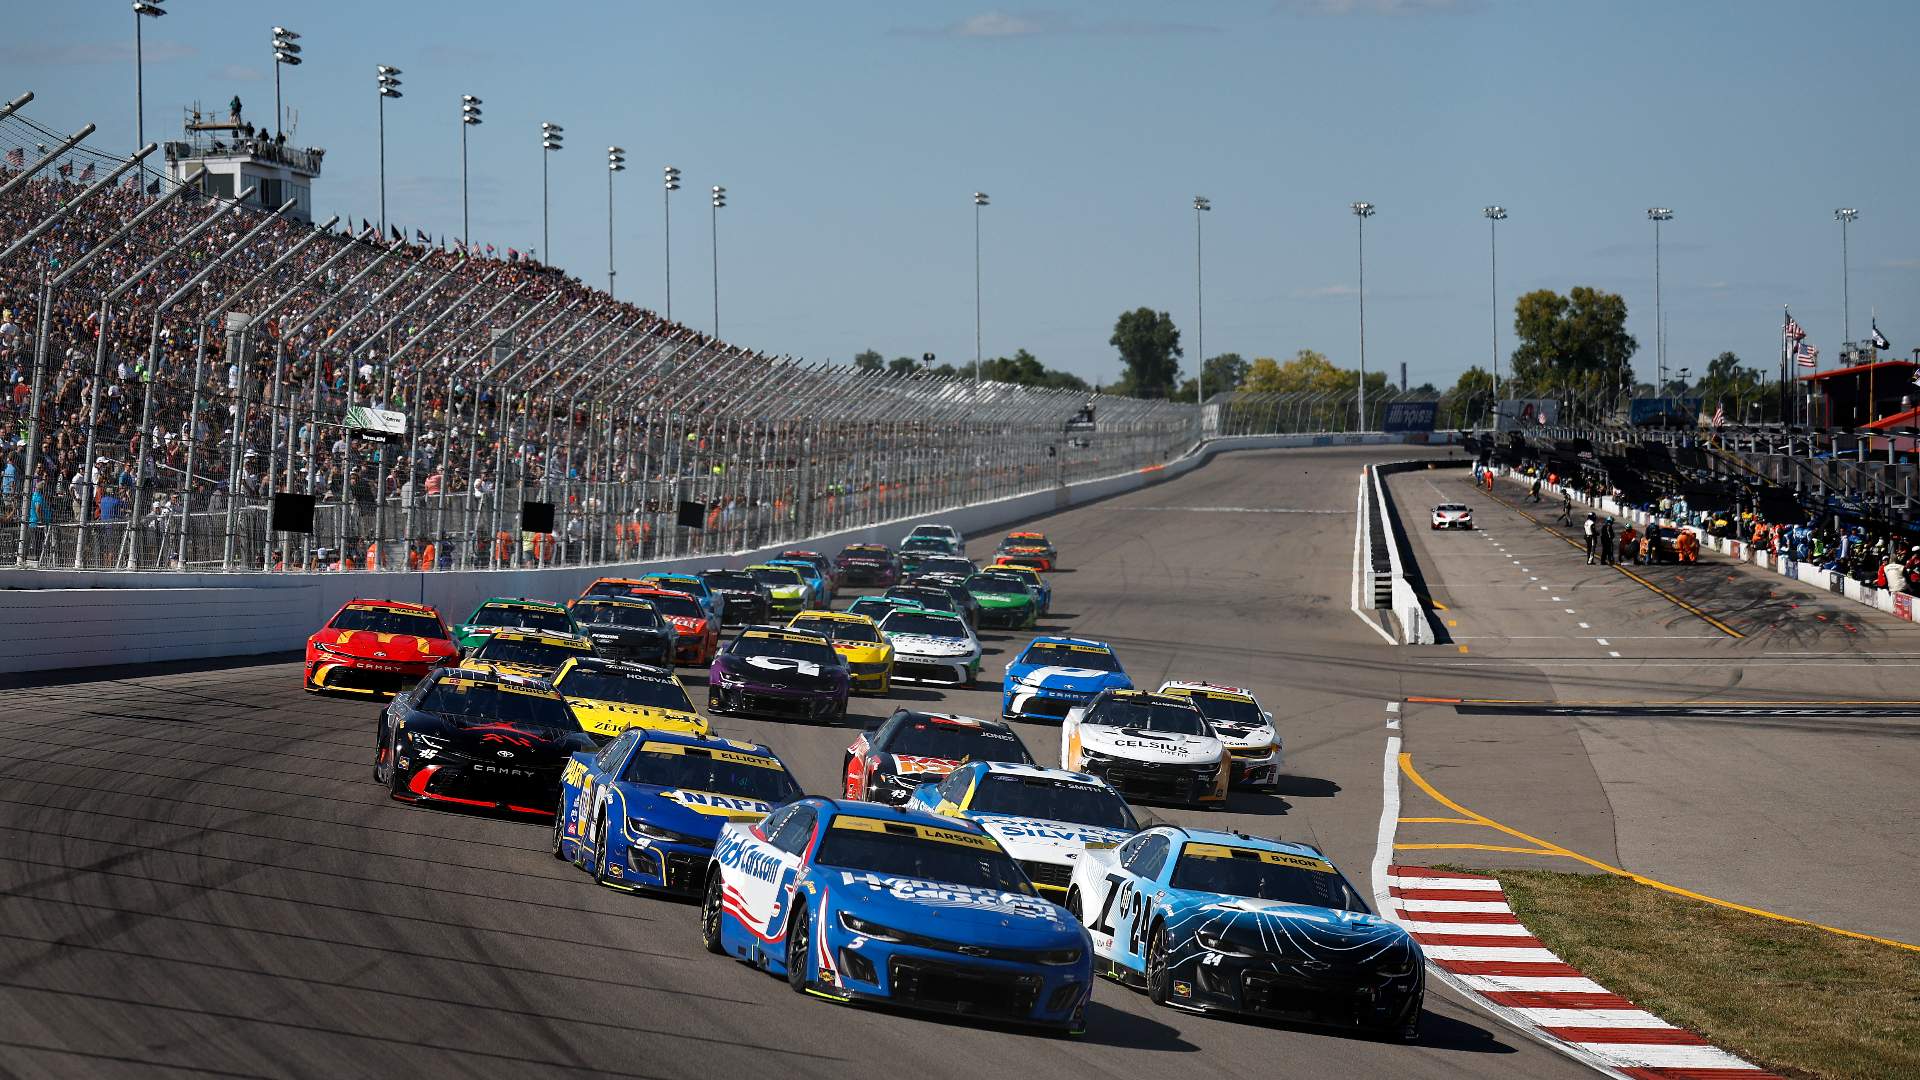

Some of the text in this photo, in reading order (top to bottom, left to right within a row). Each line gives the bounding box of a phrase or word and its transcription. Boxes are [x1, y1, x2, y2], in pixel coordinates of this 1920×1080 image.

[356, 663, 401, 672] CAMRY
[1048, 691, 1088, 701] CAMRY
[1114, 739, 1189, 755] CELSIUS
[720, 752, 772, 767] ELLIOTT
[473, 763, 536, 777] CAMRY
[1067, 783, 1102, 794] SMITH
[682, 791, 770, 814] NAPA
[924, 828, 985, 847] LARSON
[1270, 854, 1318, 869] BYRON
[766, 866, 798, 938] 5
[1128, 890, 1153, 959] 24
[846, 935, 869, 950] 5
[1202, 952, 1224, 967] 24
